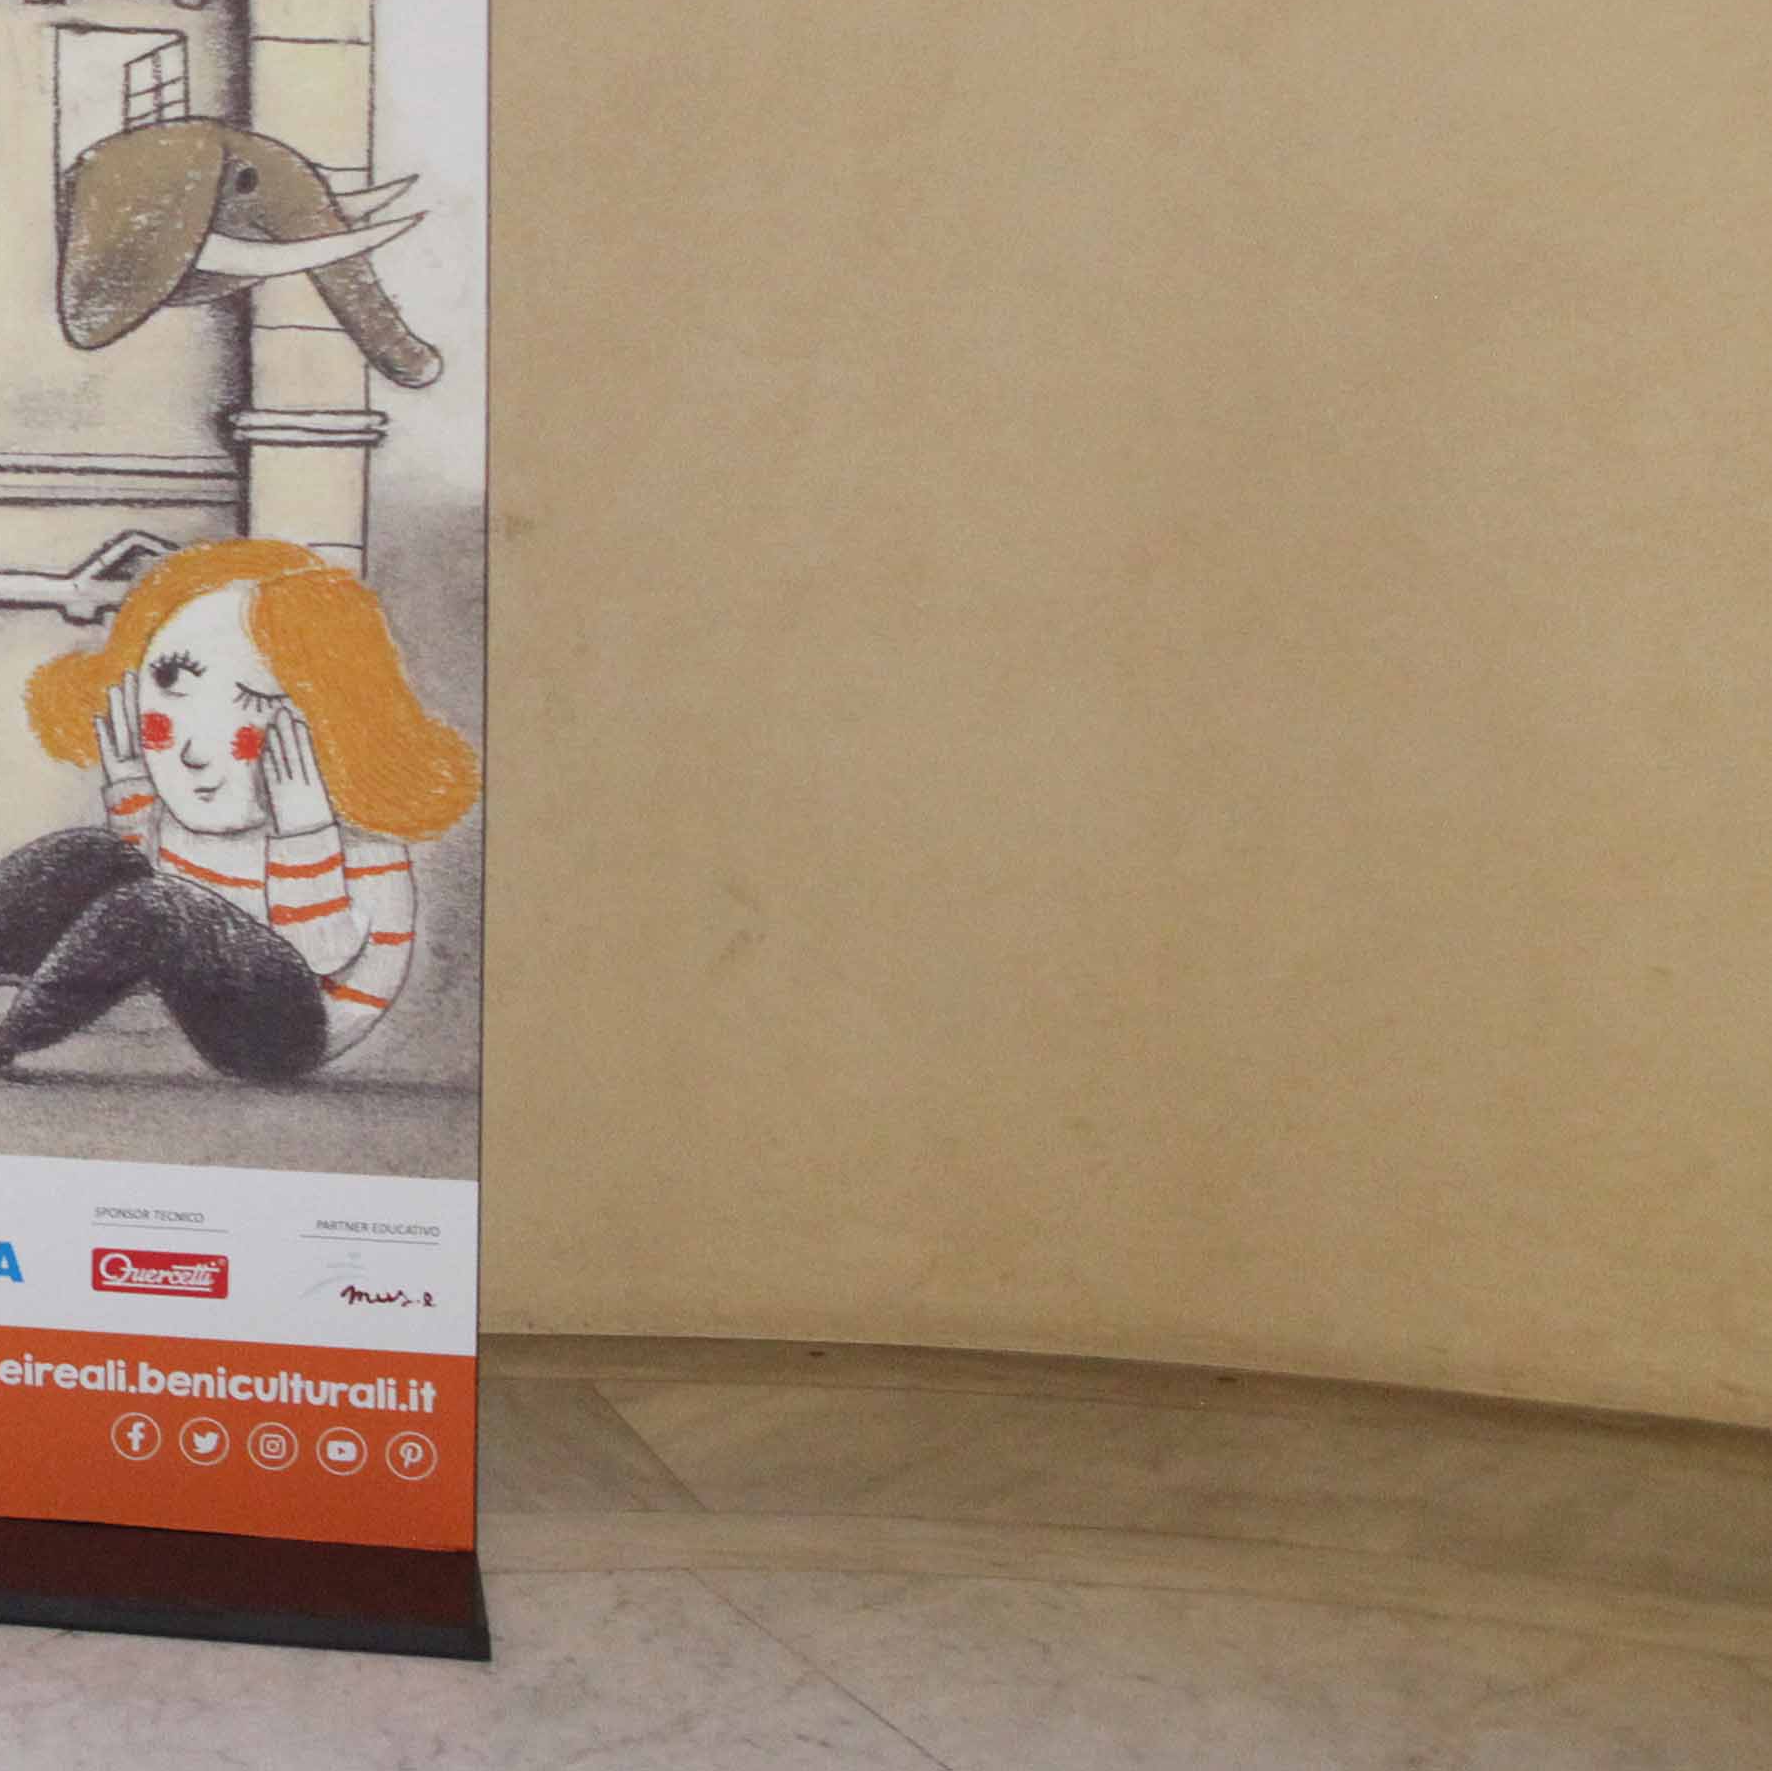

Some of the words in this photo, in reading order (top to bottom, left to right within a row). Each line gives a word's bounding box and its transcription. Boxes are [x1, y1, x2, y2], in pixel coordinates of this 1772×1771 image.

[95, 1206, 151, 1220] SPONSOR
[153, 1209, 205, 1223] TECNICO
[316, 1220, 369, 1233] PARTNER
[372, 1223, 441, 1237] EDUCATIVO
[98, 1252, 217, 1286] Quercetti
